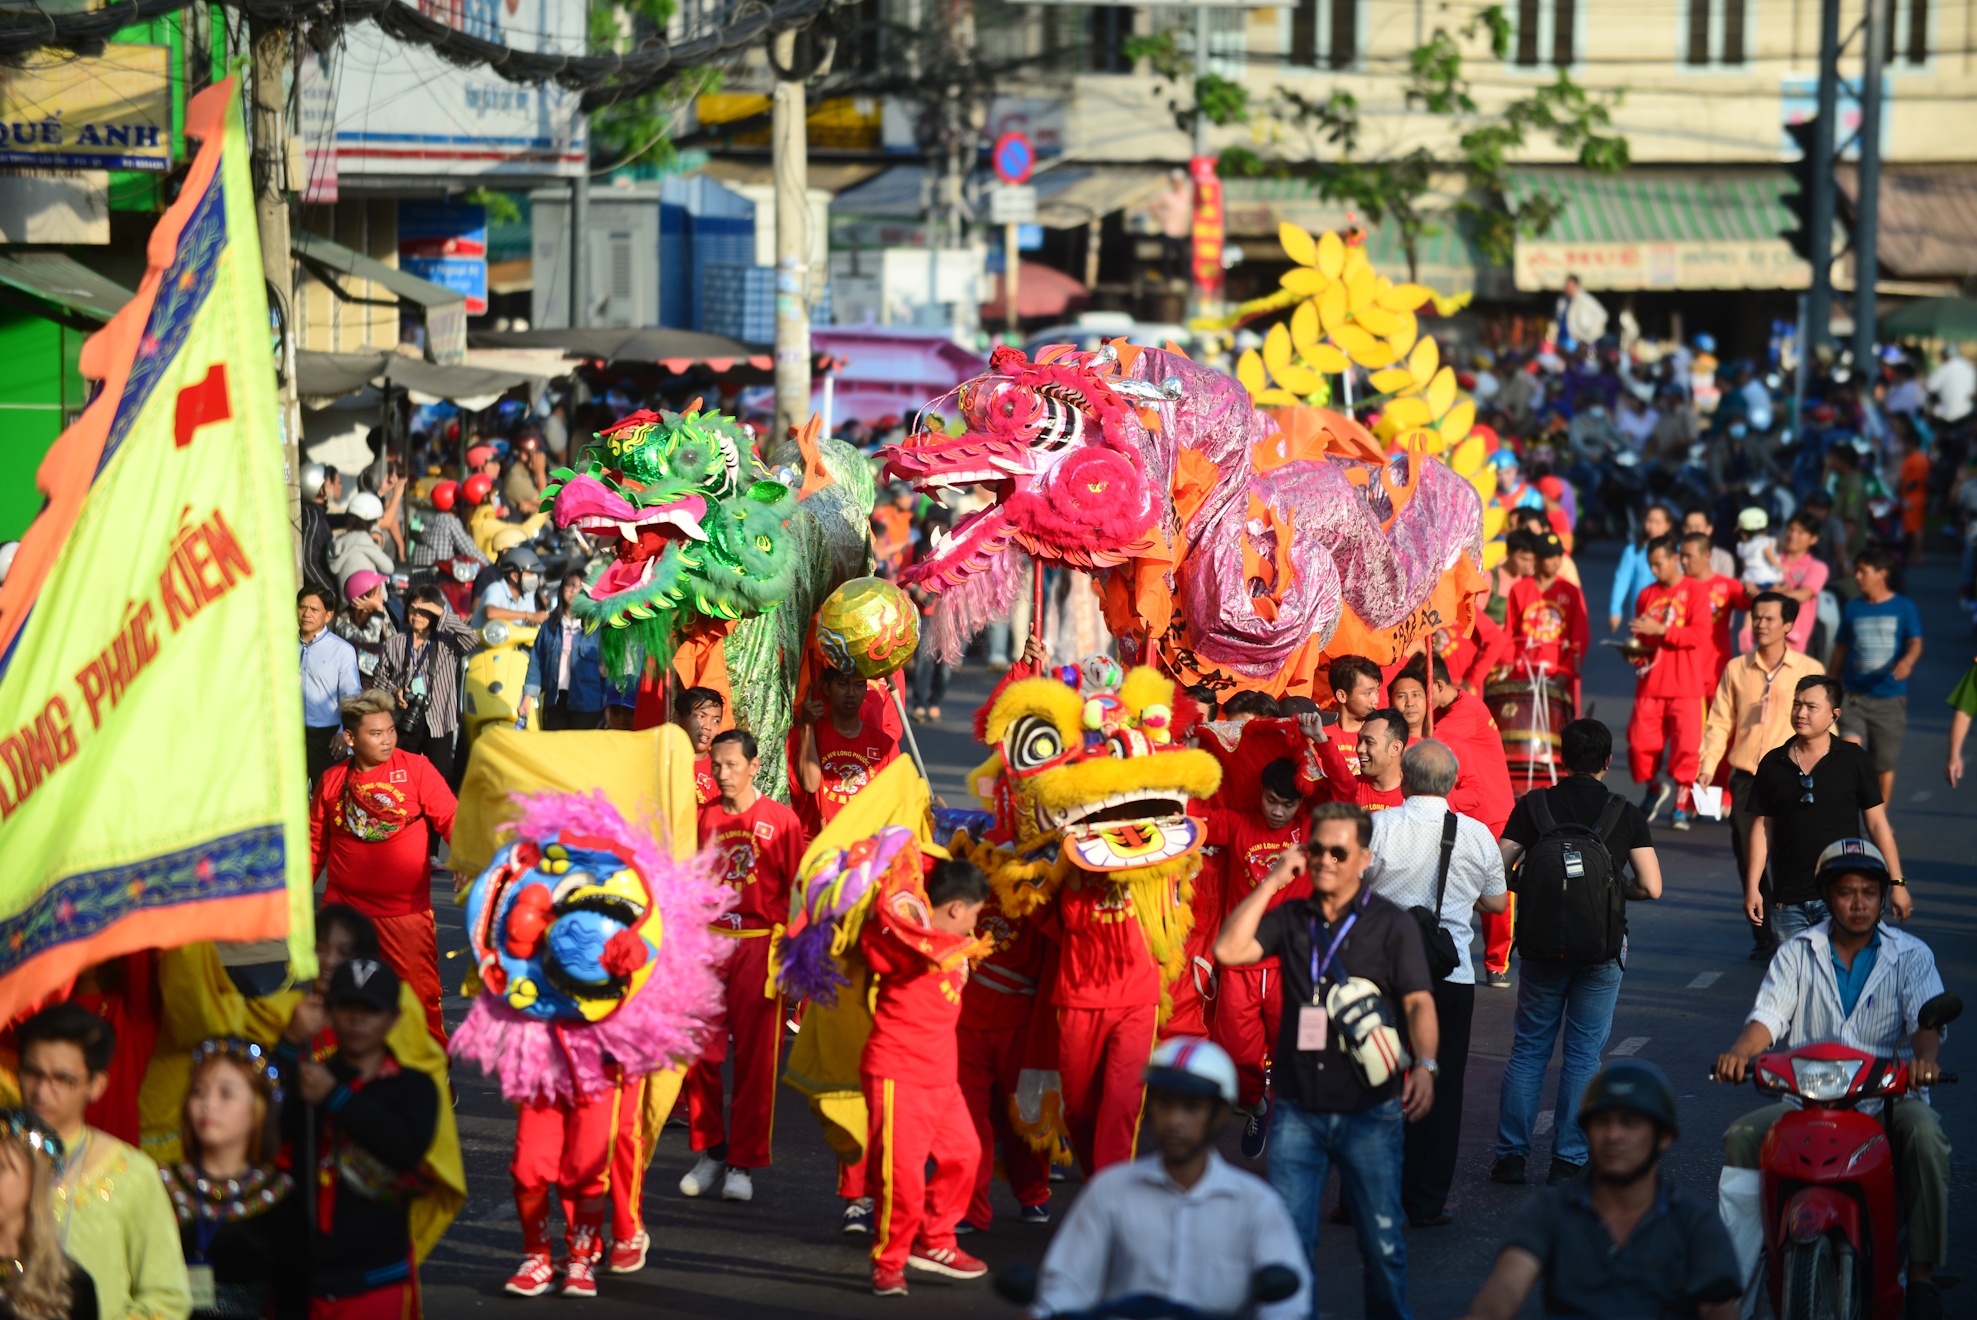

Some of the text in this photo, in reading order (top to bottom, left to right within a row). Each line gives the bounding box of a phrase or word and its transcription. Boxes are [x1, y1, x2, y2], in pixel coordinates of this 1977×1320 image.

[76, 124, 160, 147] ANH
[0, 695, 79, 823] LONG
[159, 504, 254, 633] KIẾN
[1369, 803, 1384, 811] LONG
[352, 959, 380, 989] V
